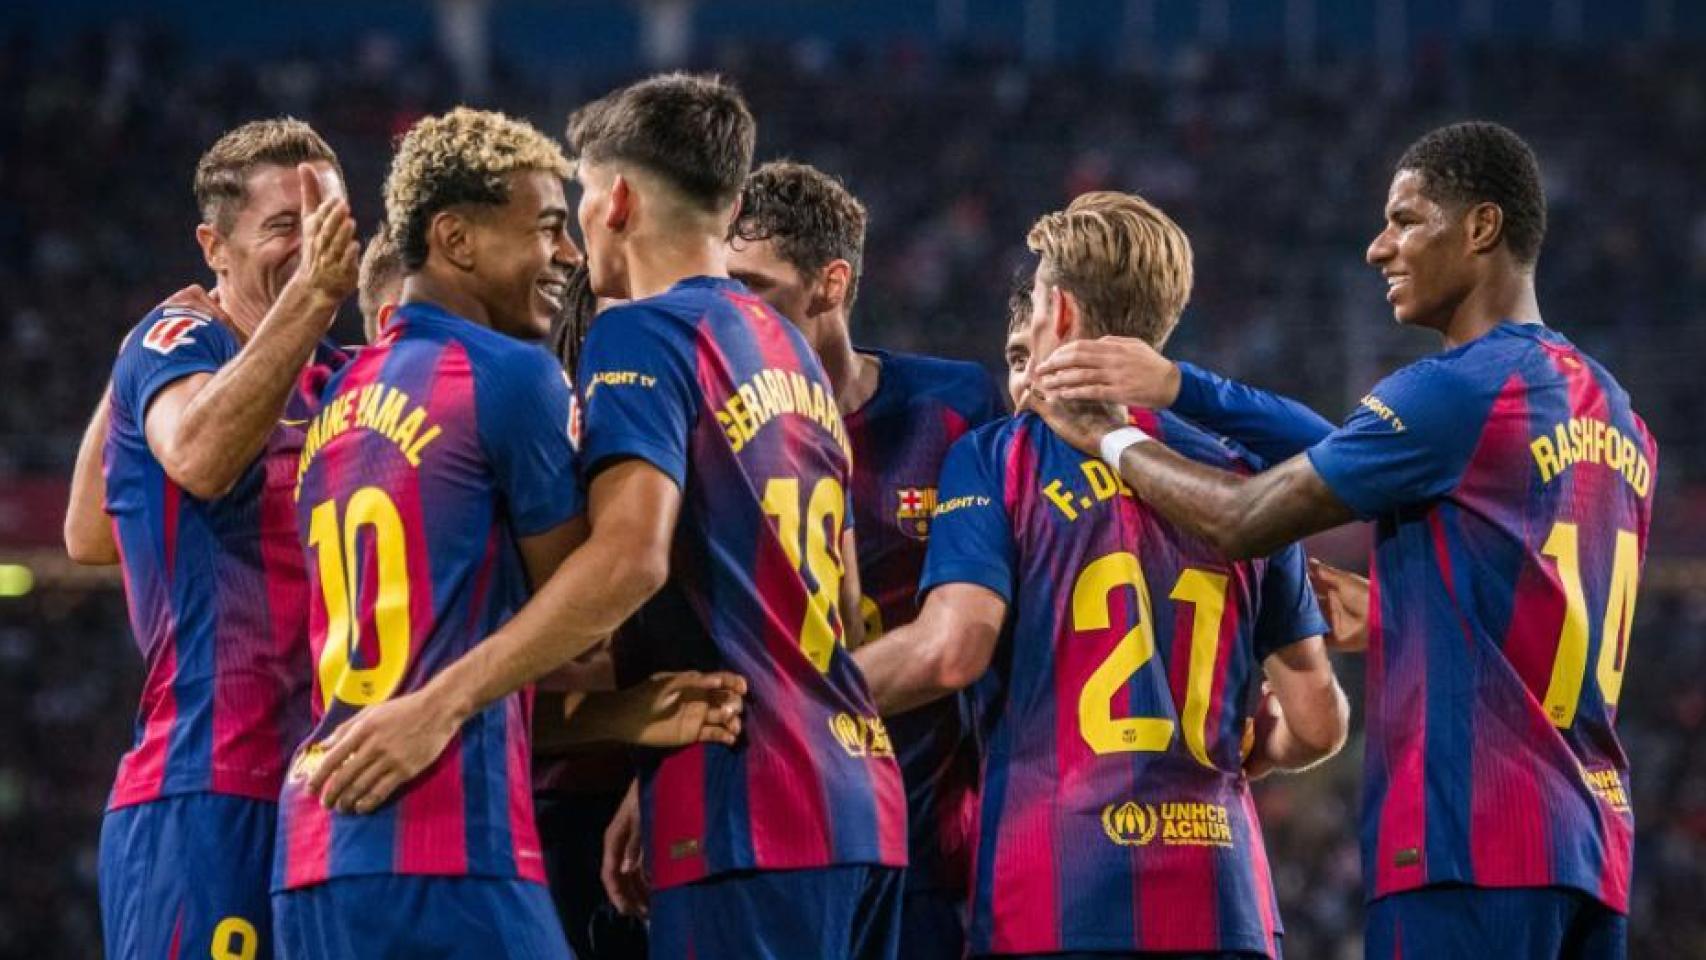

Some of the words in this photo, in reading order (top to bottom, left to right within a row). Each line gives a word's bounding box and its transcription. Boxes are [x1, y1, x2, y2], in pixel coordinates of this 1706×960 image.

[356, 383, 442, 467] YAMAL
[714, 368, 797, 453] GERARD
[1530, 416, 1649, 497] RASHFORD
[308, 486, 409, 713] 10
[1541, 522, 1639, 729] 14
[1073, 552, 1229, 768] 21
[1162, 803, 1228, 824] UNHCR
[1162, 820, 1232, 840] ACNUR
